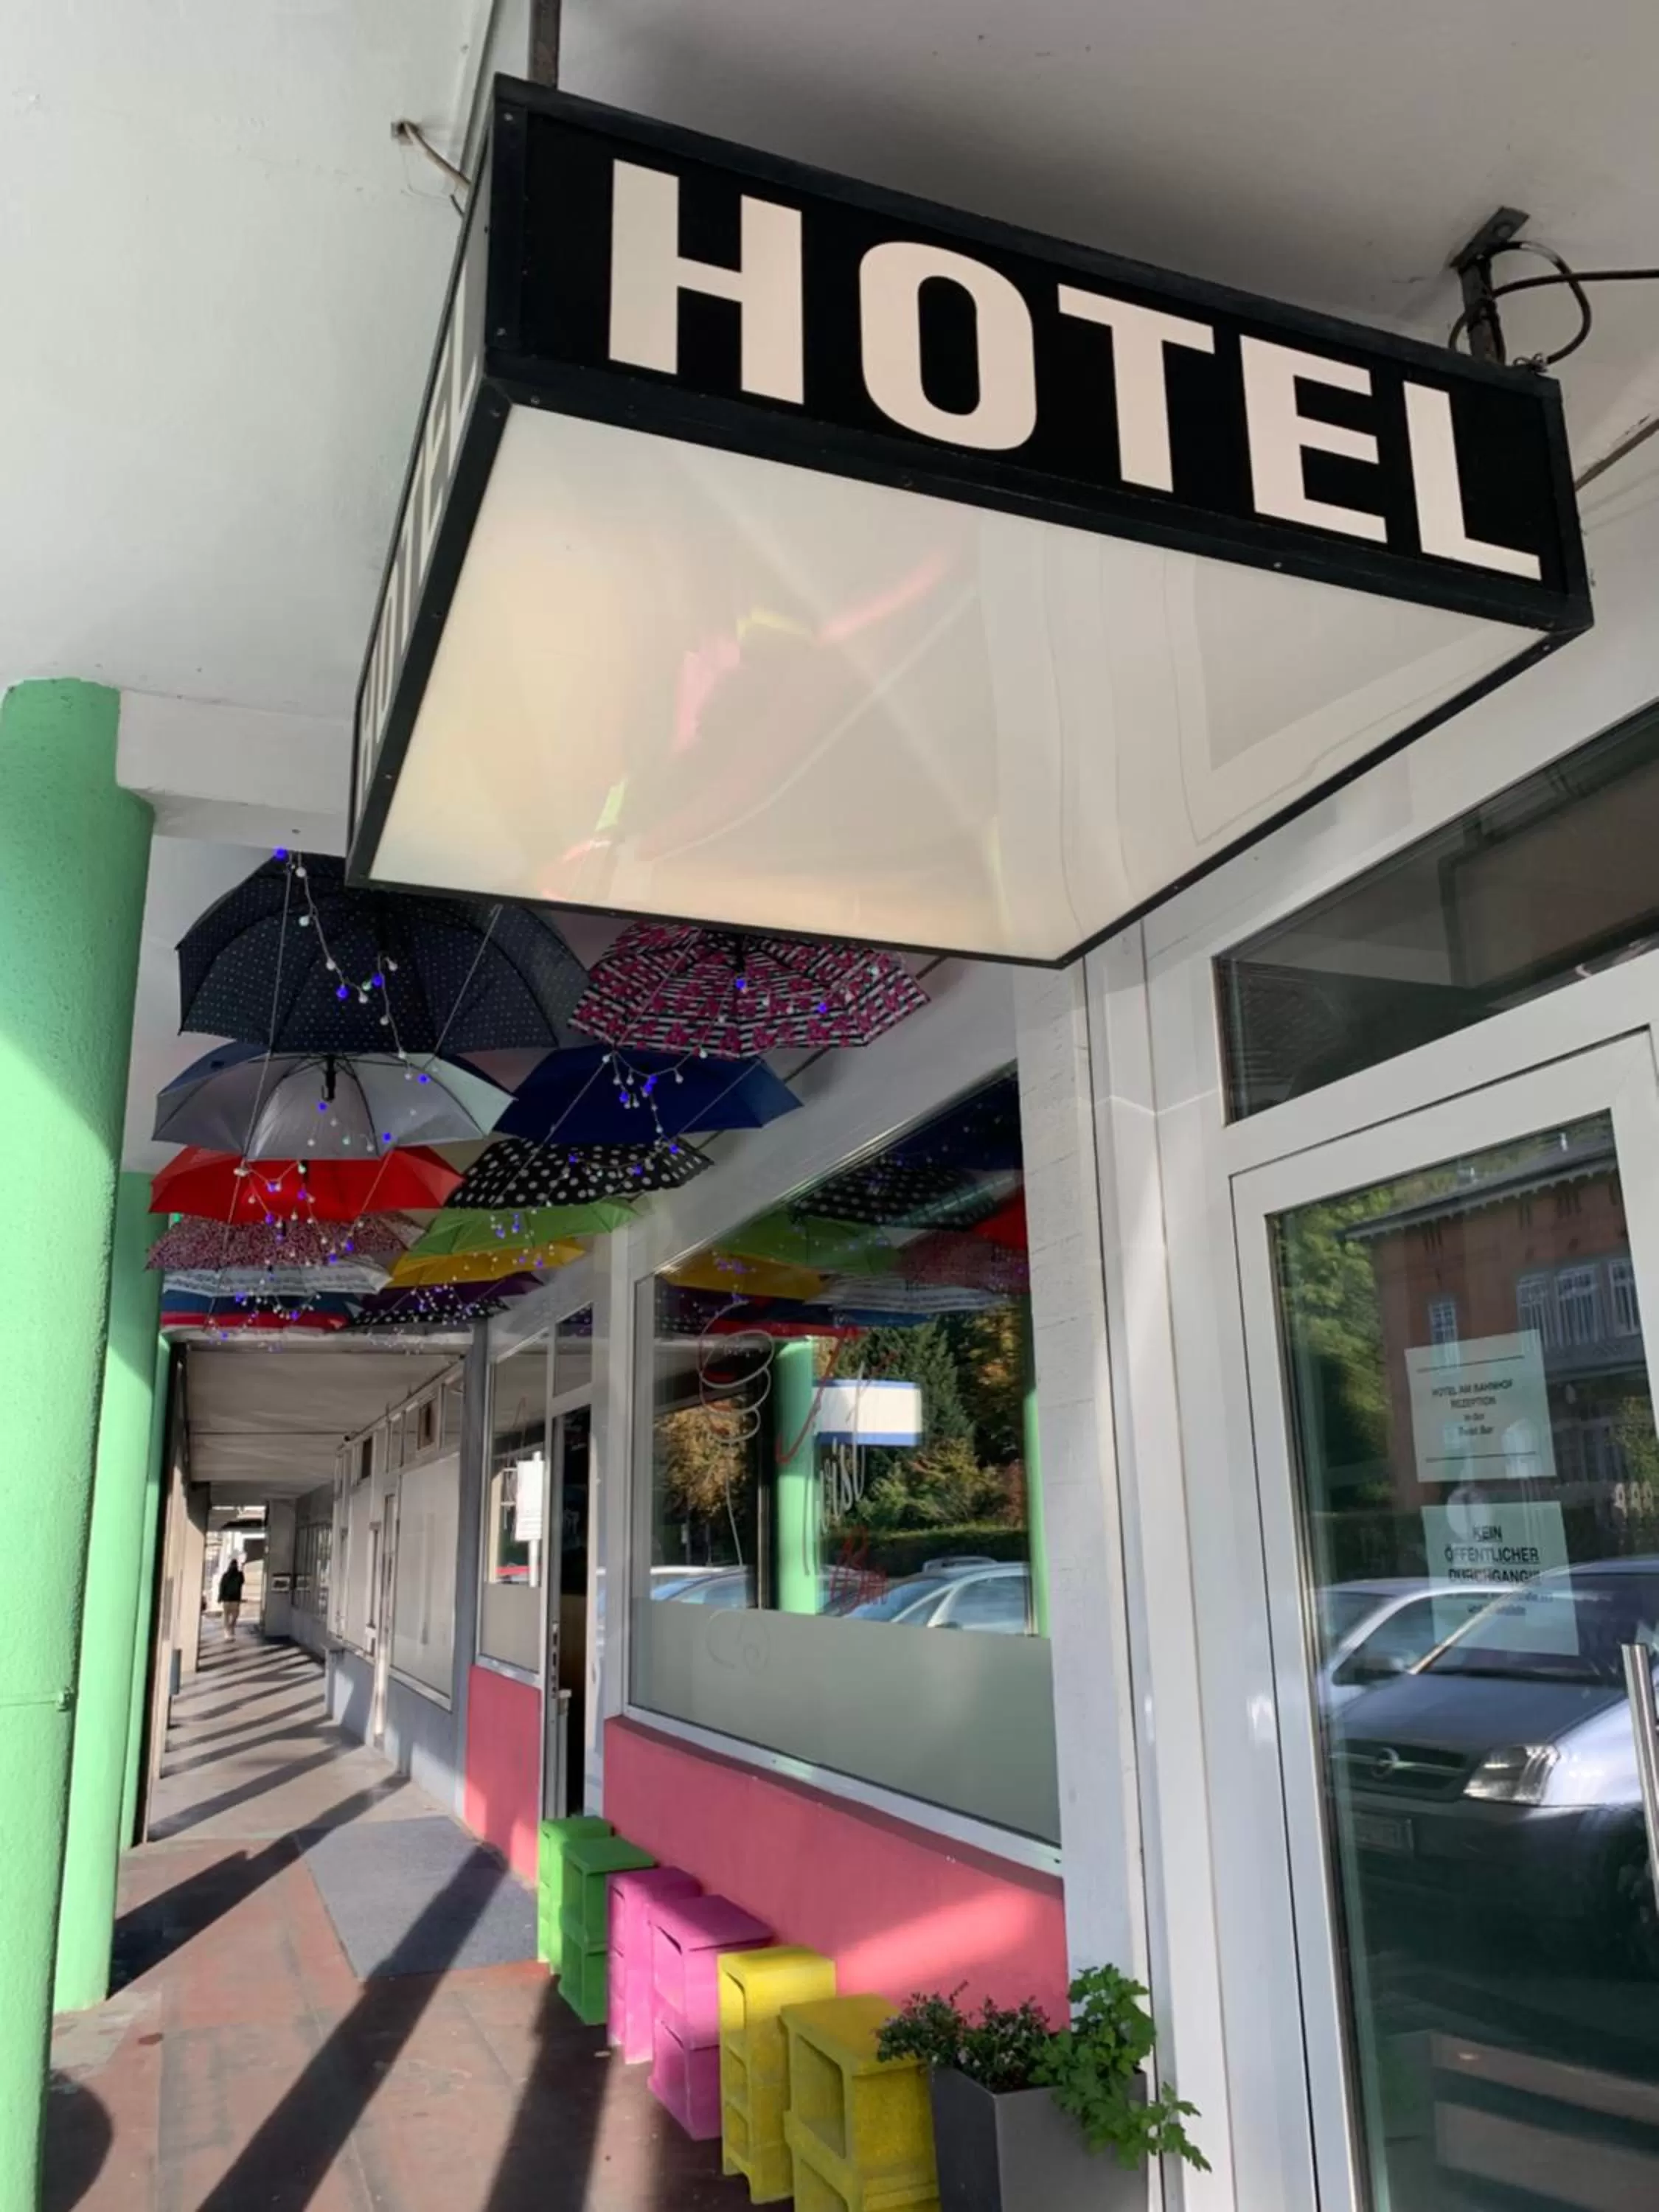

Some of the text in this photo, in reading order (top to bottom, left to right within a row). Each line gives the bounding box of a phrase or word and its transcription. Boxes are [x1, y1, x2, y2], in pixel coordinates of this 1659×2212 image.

[607, 158, 1543, 581] HOTEL
[356, 258, 477, 823] HOTEL
[1444, 1544, 1540, 1563] ÖFFENTLICHER
[1473, 1526, 1503, 1543] KEIN
